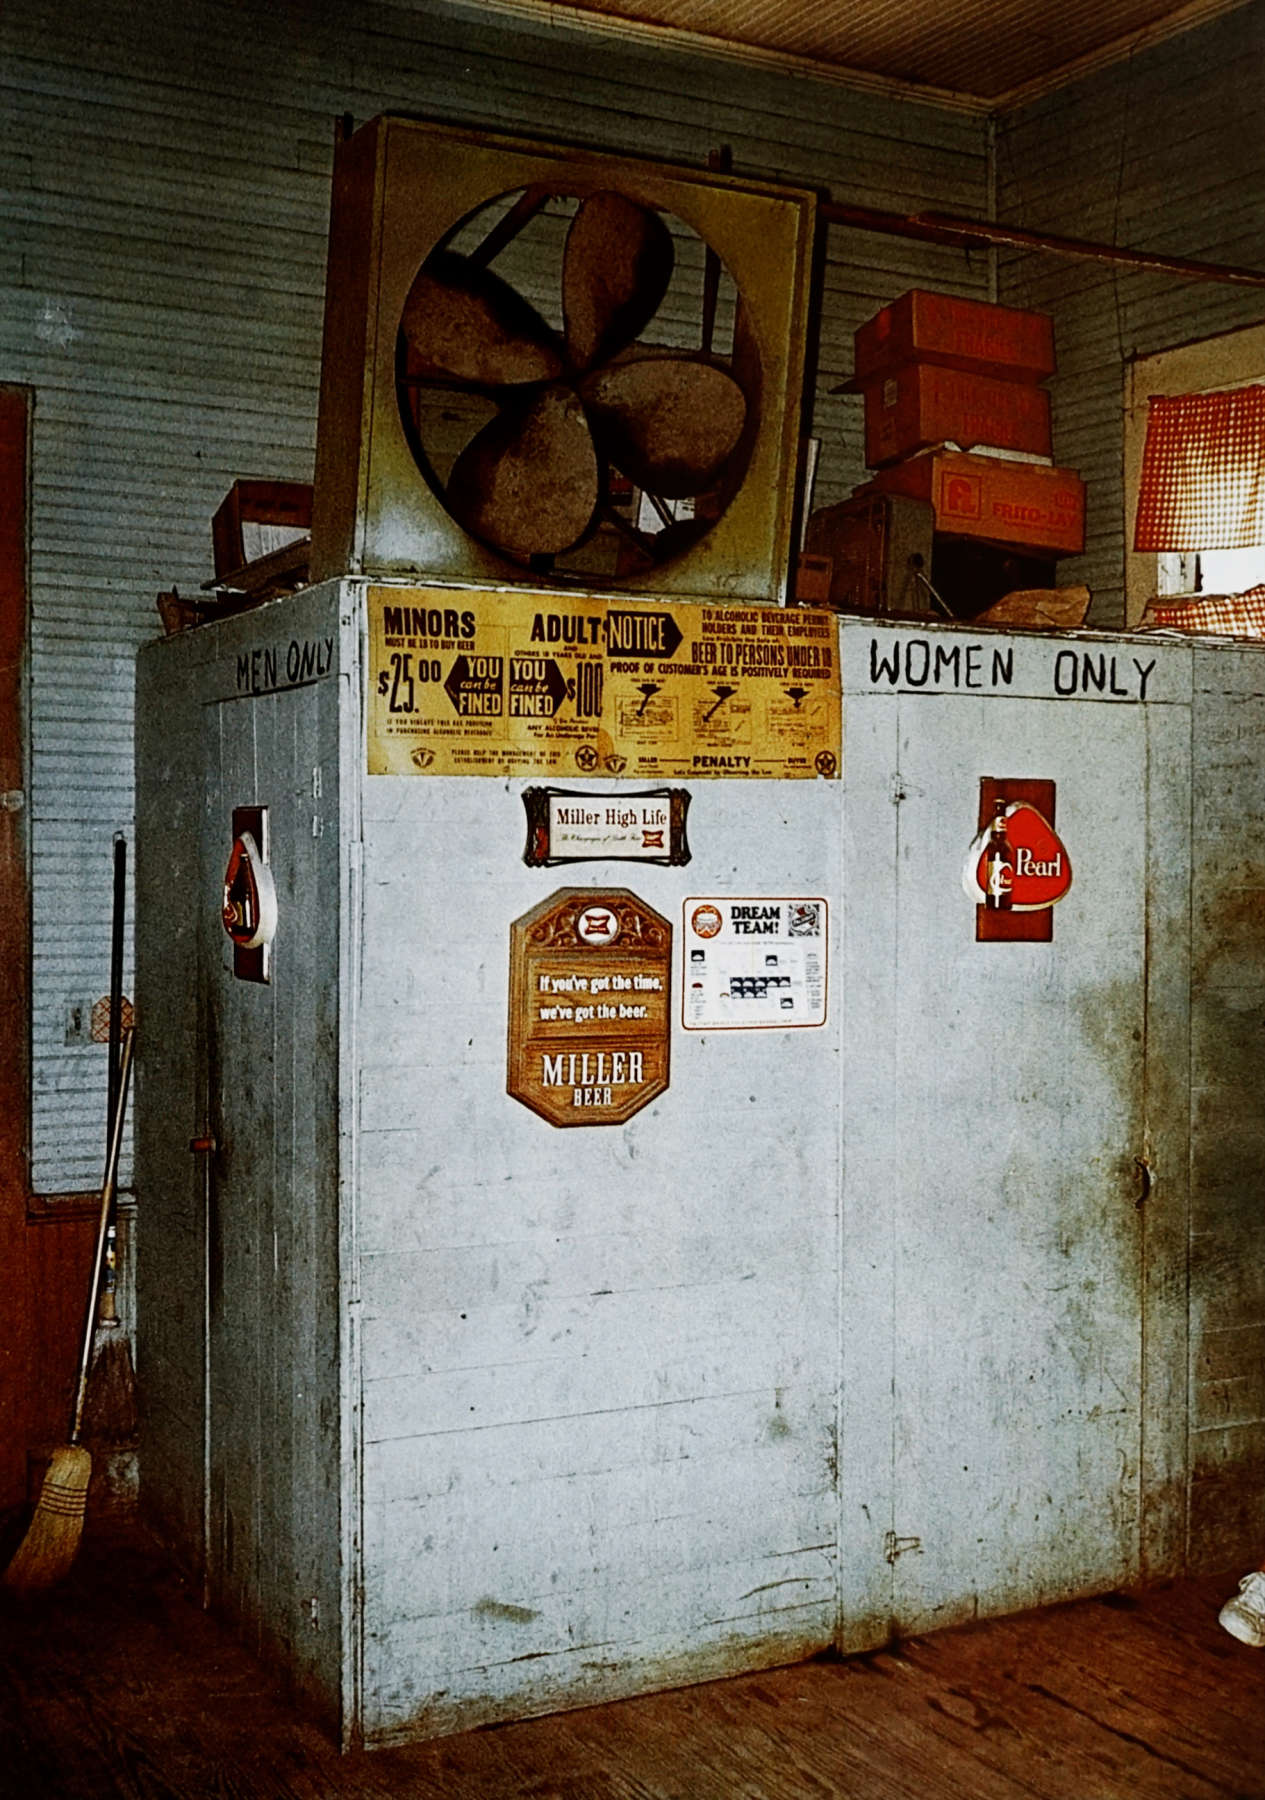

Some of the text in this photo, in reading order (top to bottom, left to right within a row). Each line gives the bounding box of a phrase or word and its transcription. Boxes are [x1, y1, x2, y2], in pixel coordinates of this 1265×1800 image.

[384, 607, 475, 638] MINORS
[703, 609, 712, 620] TO
[715, 610, 758, 622] ALCOHOLIC
[762, 612, 800, 624] BEVERAGE
[610, 616, 666, 650] NOTICE
[702, 622, 829, 638] HOLDERS AND THEIR EMPLOYEES
[692, 642, 716, 664] BEER
[720, 643, 733, 664] TO
[736, 643, 784, 666] PERSONS
[787, 646, 820, 667] UNDER
[237, 637, 333, 695] MEN ONLY
[466, 658, 499, 678] YOU
[512, 659, 546, 680] YOU
[610, 662, 831, 679] PROOF OF CUSTOMER'S AGE IS POSITIVELY REQUIRED
[870, 639, 1156, 700] WOMEN ONLY
[460, 678, 496, 690] can be
[510, 681, 547, 693] can be
[460, 693, 500, 714] FINED
[511, 695, 553, 715] FINED
[693, 756, 751, 768] PENALTY
[557, 809, 666, 828] Miller High Life
[1016, 848, 1061, 876] Pearl
[731, 906, 780, 919] DREAM
[732, 922, 779, 934] TEAM!
[540, 974, 662, 994] If you've got the time,
[540, 1004, 648, 1022] we've got the beer.
[542, 1052, 643, 1086] MILLER
[574, 1087, 612, 1107] BEER
